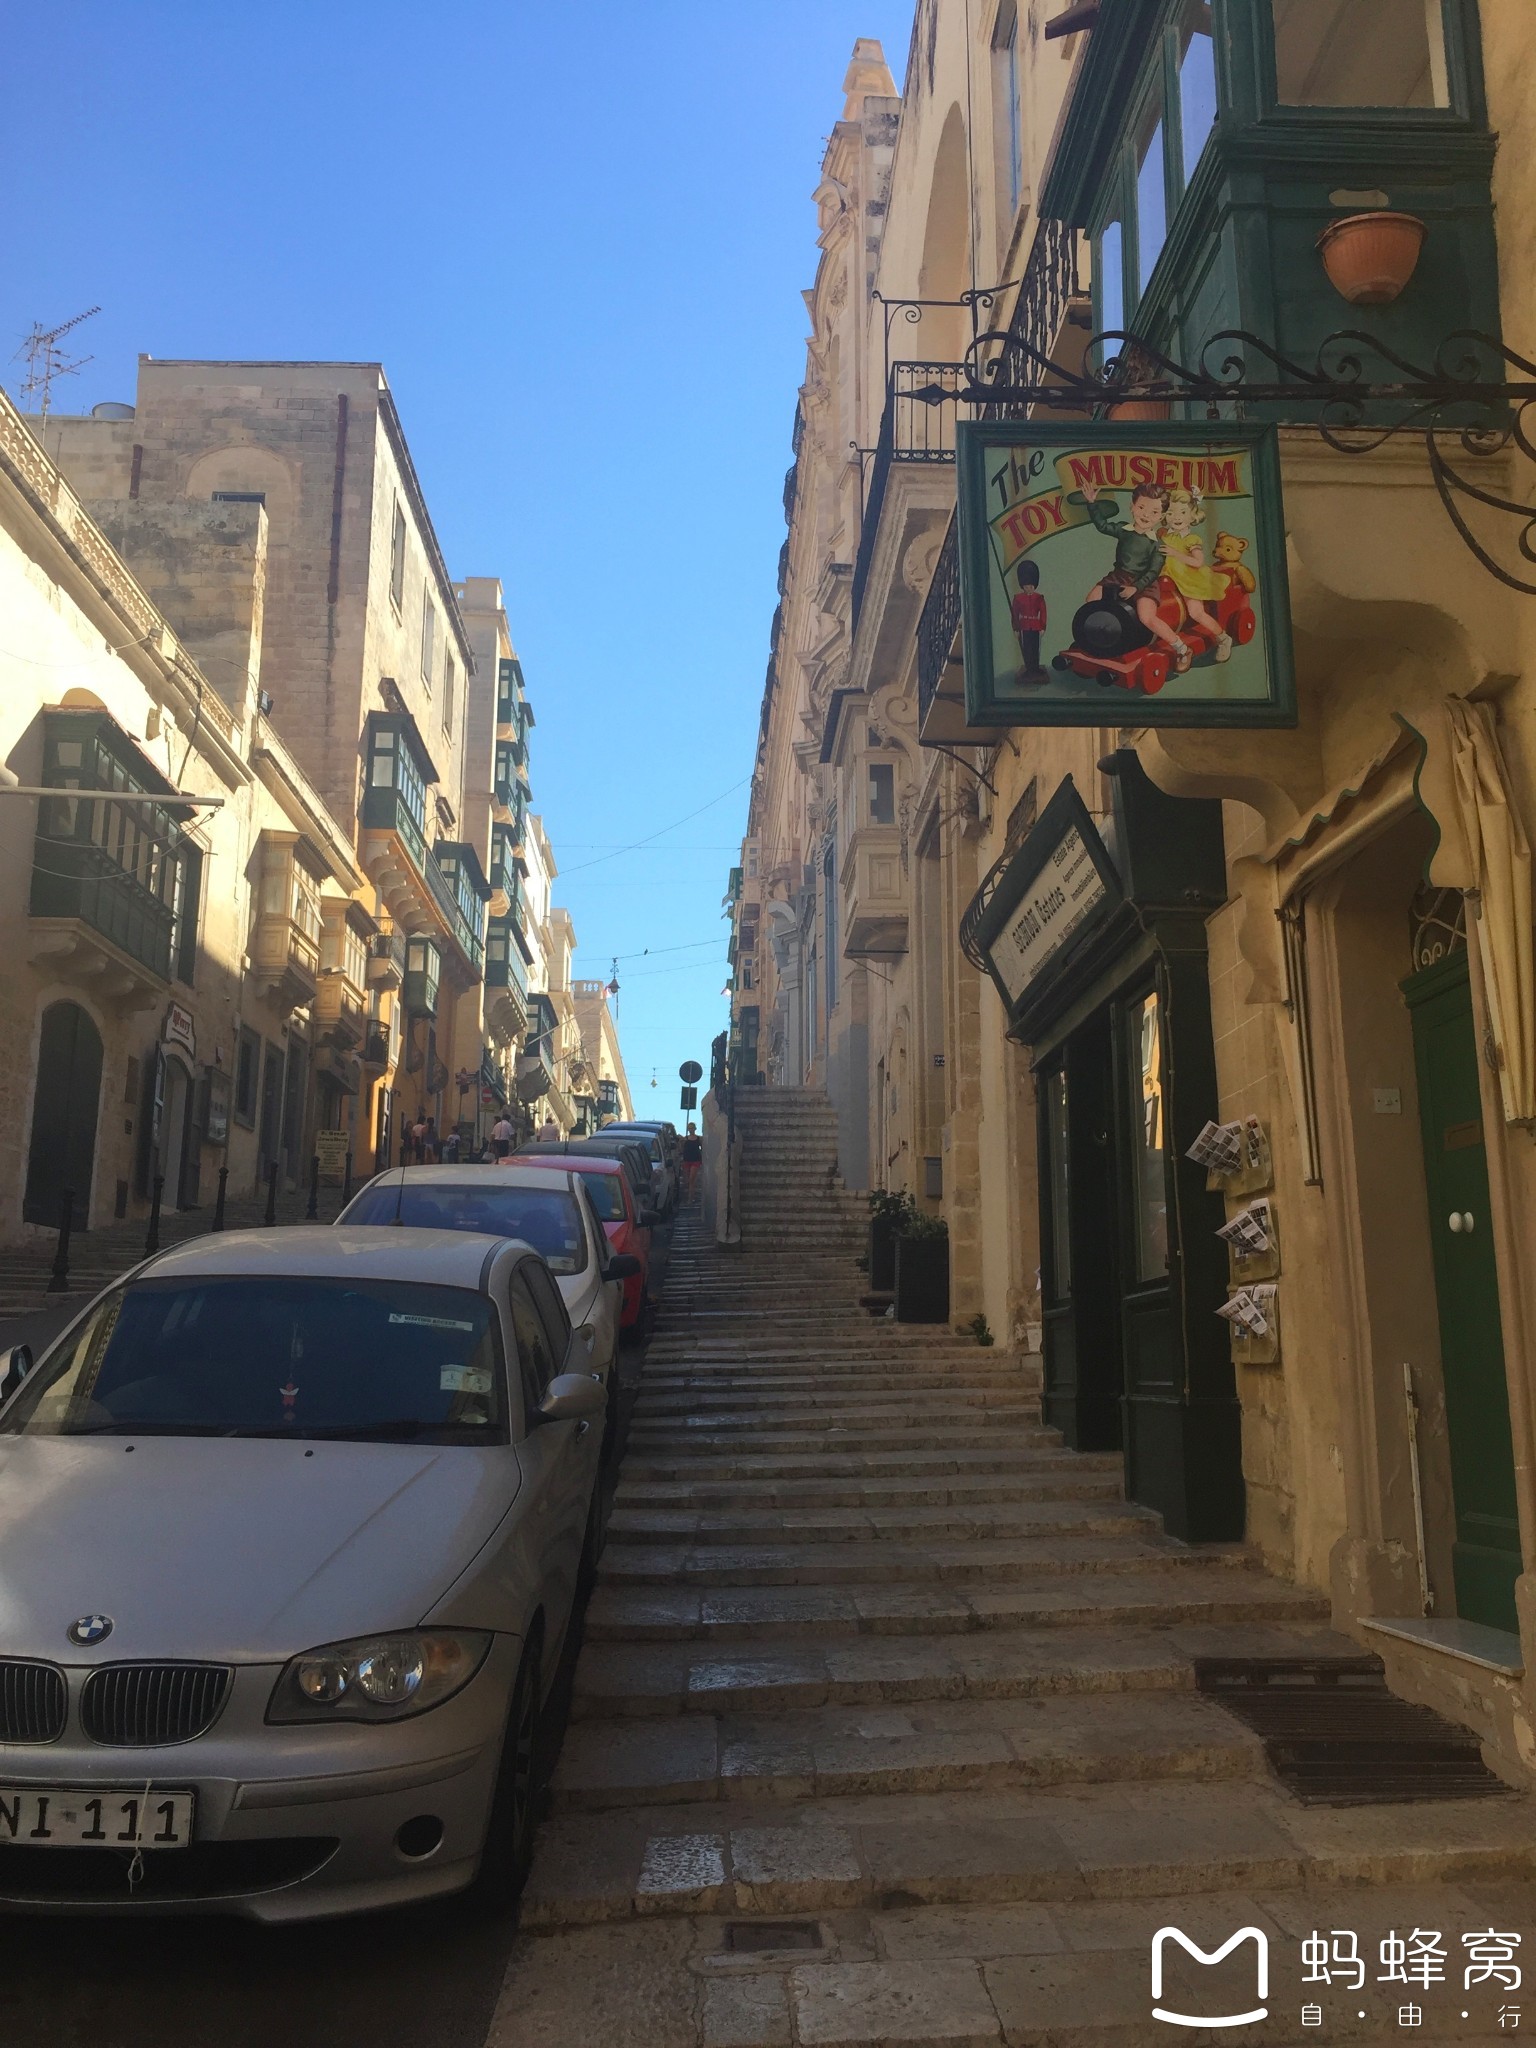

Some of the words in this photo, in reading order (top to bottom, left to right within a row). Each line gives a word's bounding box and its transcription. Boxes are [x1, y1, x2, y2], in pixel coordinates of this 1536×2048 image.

[991, 450, 1045, 509] The
[1069, 453, 1240, 494] MUSEUM
[1001, 496, 1068, 549] TOY
[0, 1796, 52, 1838] NI
[81, 1798, 179, 1842] 111
